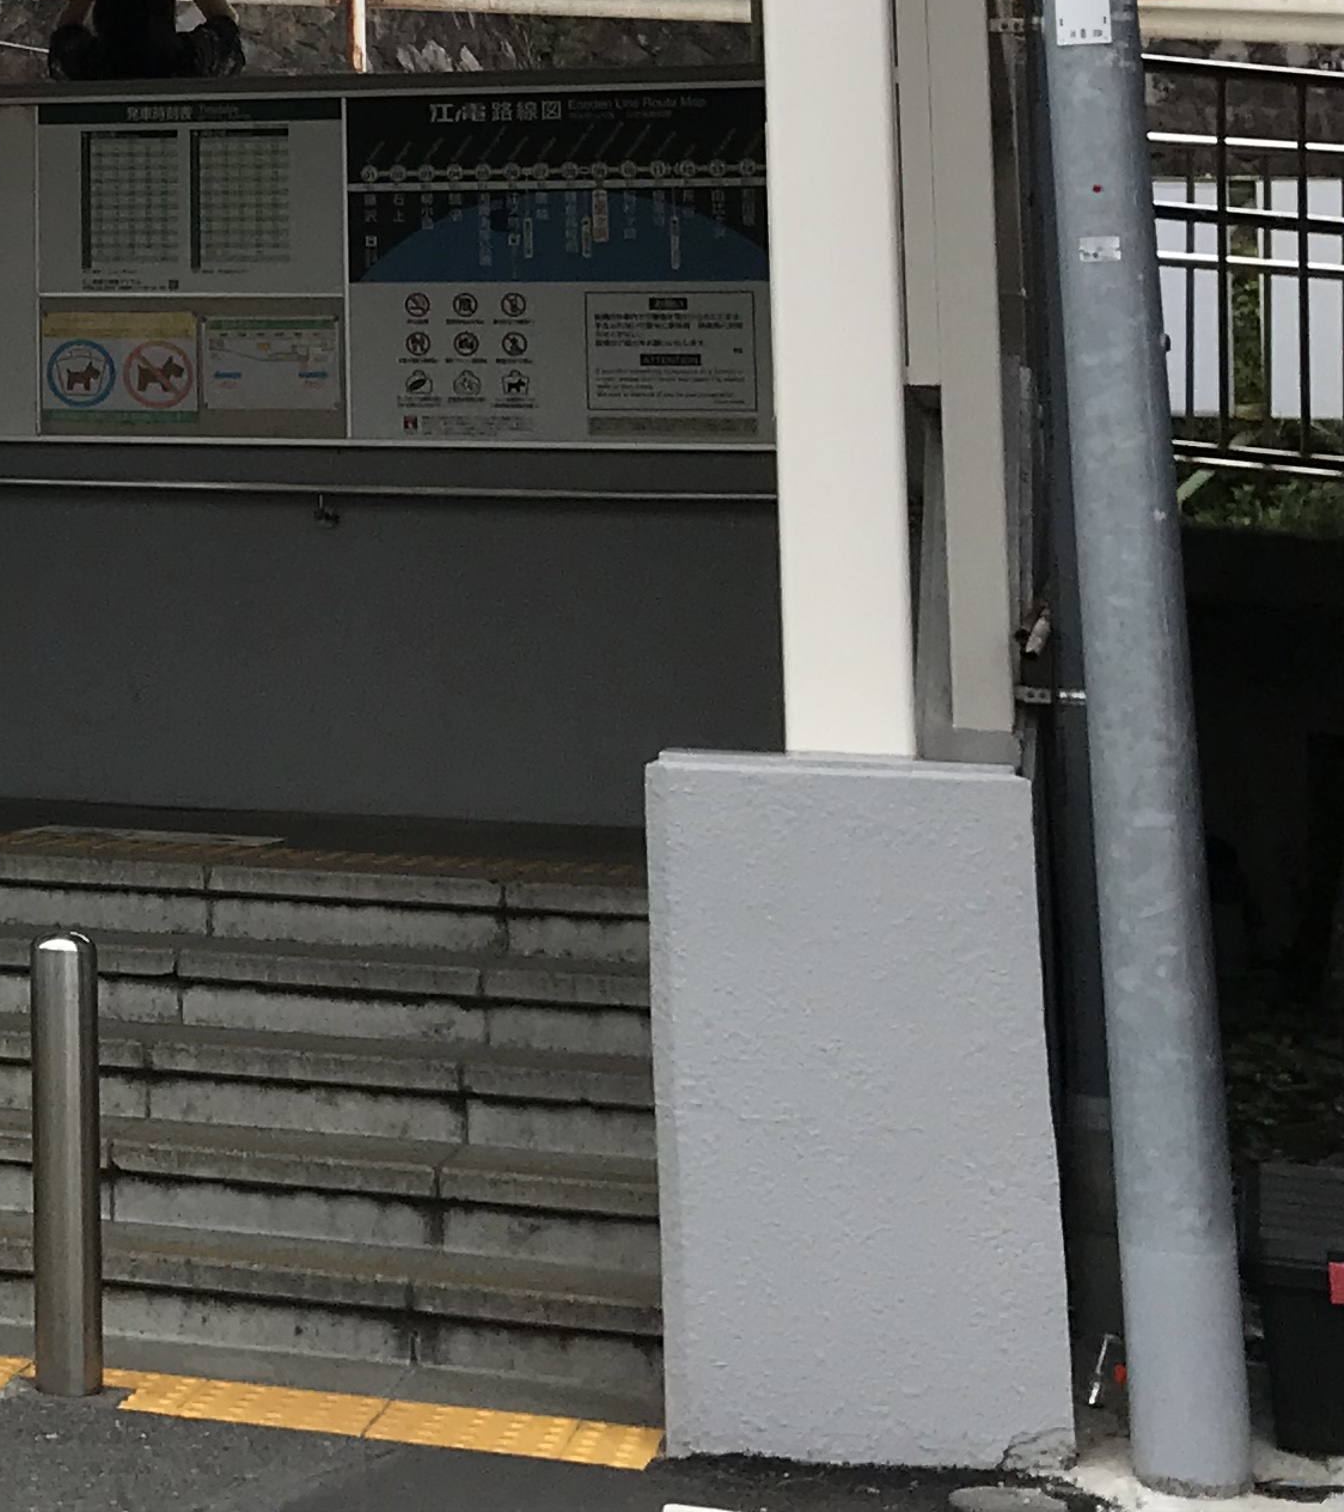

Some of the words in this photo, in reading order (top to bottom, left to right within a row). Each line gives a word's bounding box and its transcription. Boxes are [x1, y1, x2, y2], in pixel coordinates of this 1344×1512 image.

[642, 96, 677, 108] Route
[680, 95, 707, 107] Map
[491, 100, 562, 122] 路線図
